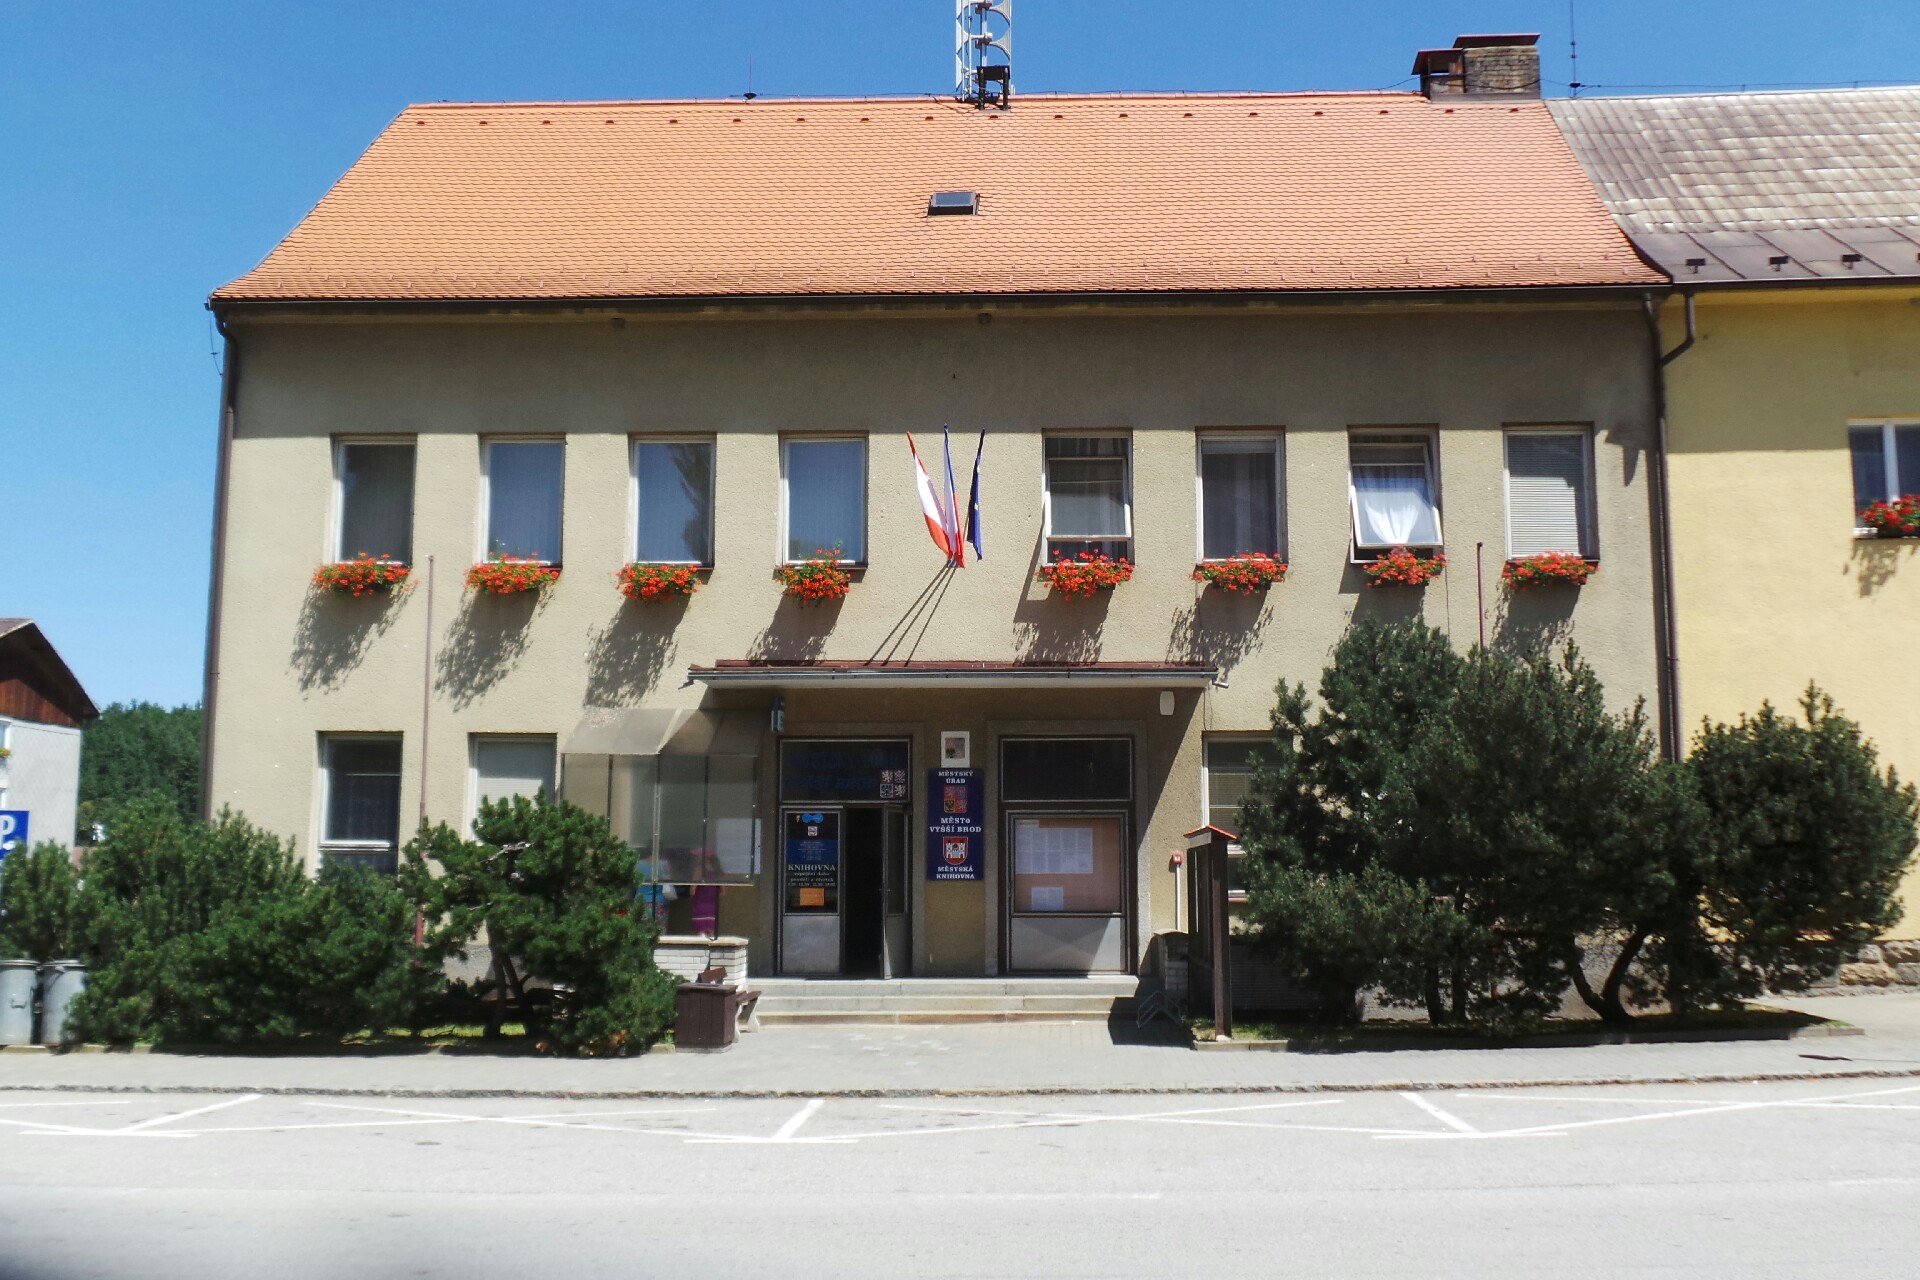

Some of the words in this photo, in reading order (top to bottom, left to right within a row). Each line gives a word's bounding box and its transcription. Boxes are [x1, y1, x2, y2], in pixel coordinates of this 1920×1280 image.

[940, 816, 971, 824] MĚSTO
[0, 815, 16, 850] P
[929, 824, 955, 833] VYŠŠÍ
